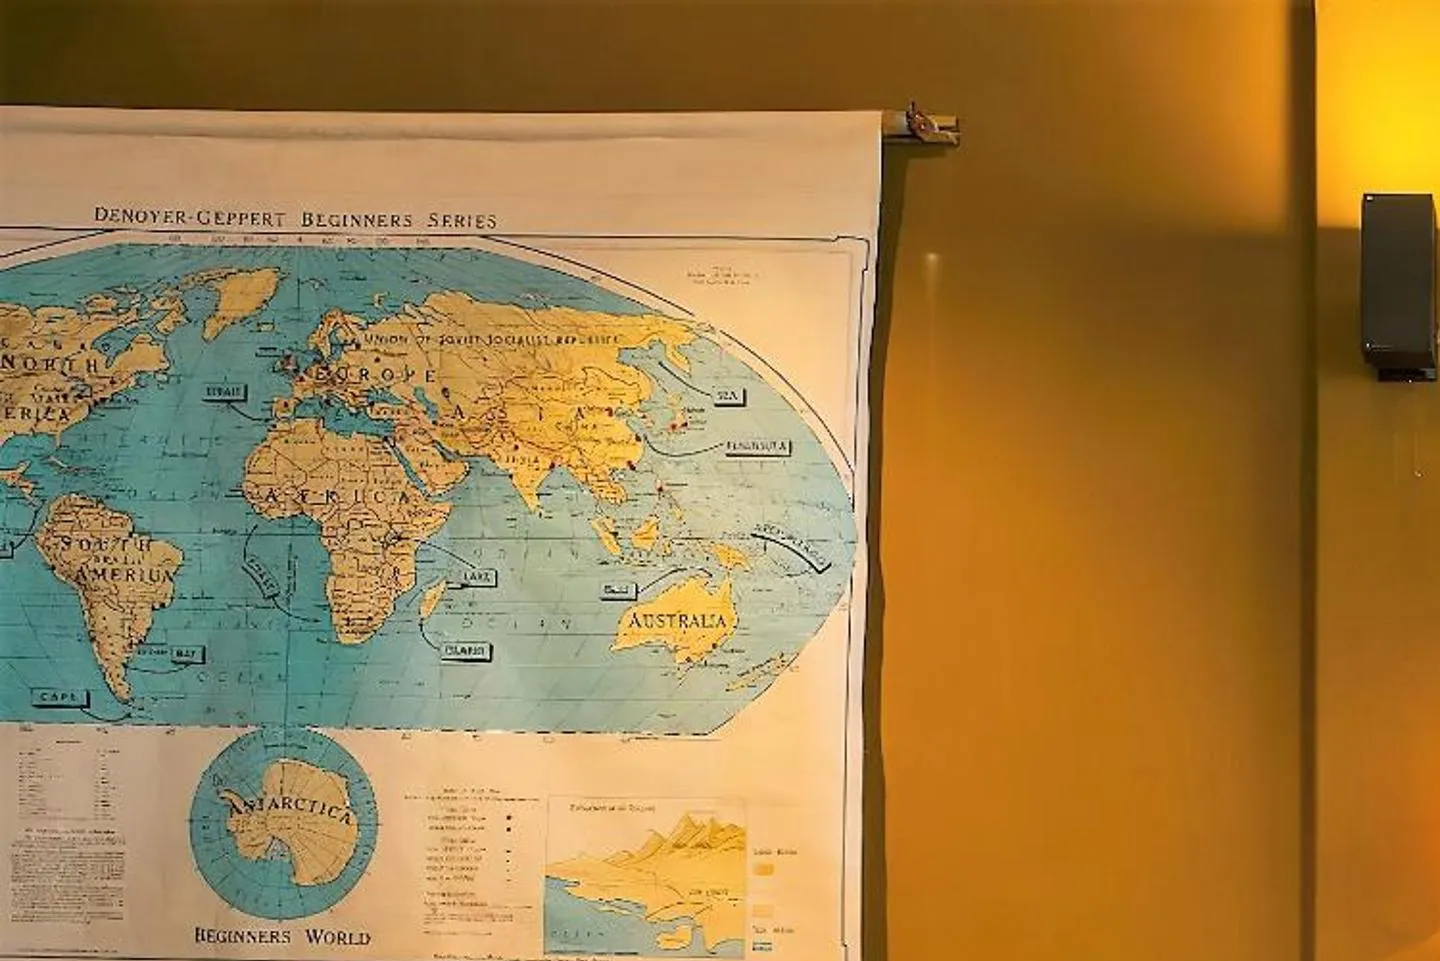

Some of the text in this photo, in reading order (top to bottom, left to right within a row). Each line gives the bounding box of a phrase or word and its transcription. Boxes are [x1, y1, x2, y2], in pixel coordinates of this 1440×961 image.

[94, 206, 497, 230] DENOYER-GEPPERT BEGINNERS SERIES
[1, 353, 98, 373] NORTH
[315, 364, 437, 383] EUROPE
[628, 611, 728, 630] AUSTRALIA
[229, 796, 351, 826] ANTARCTICA
[194, 925, 372, 947] BEGINNERS WORLD
